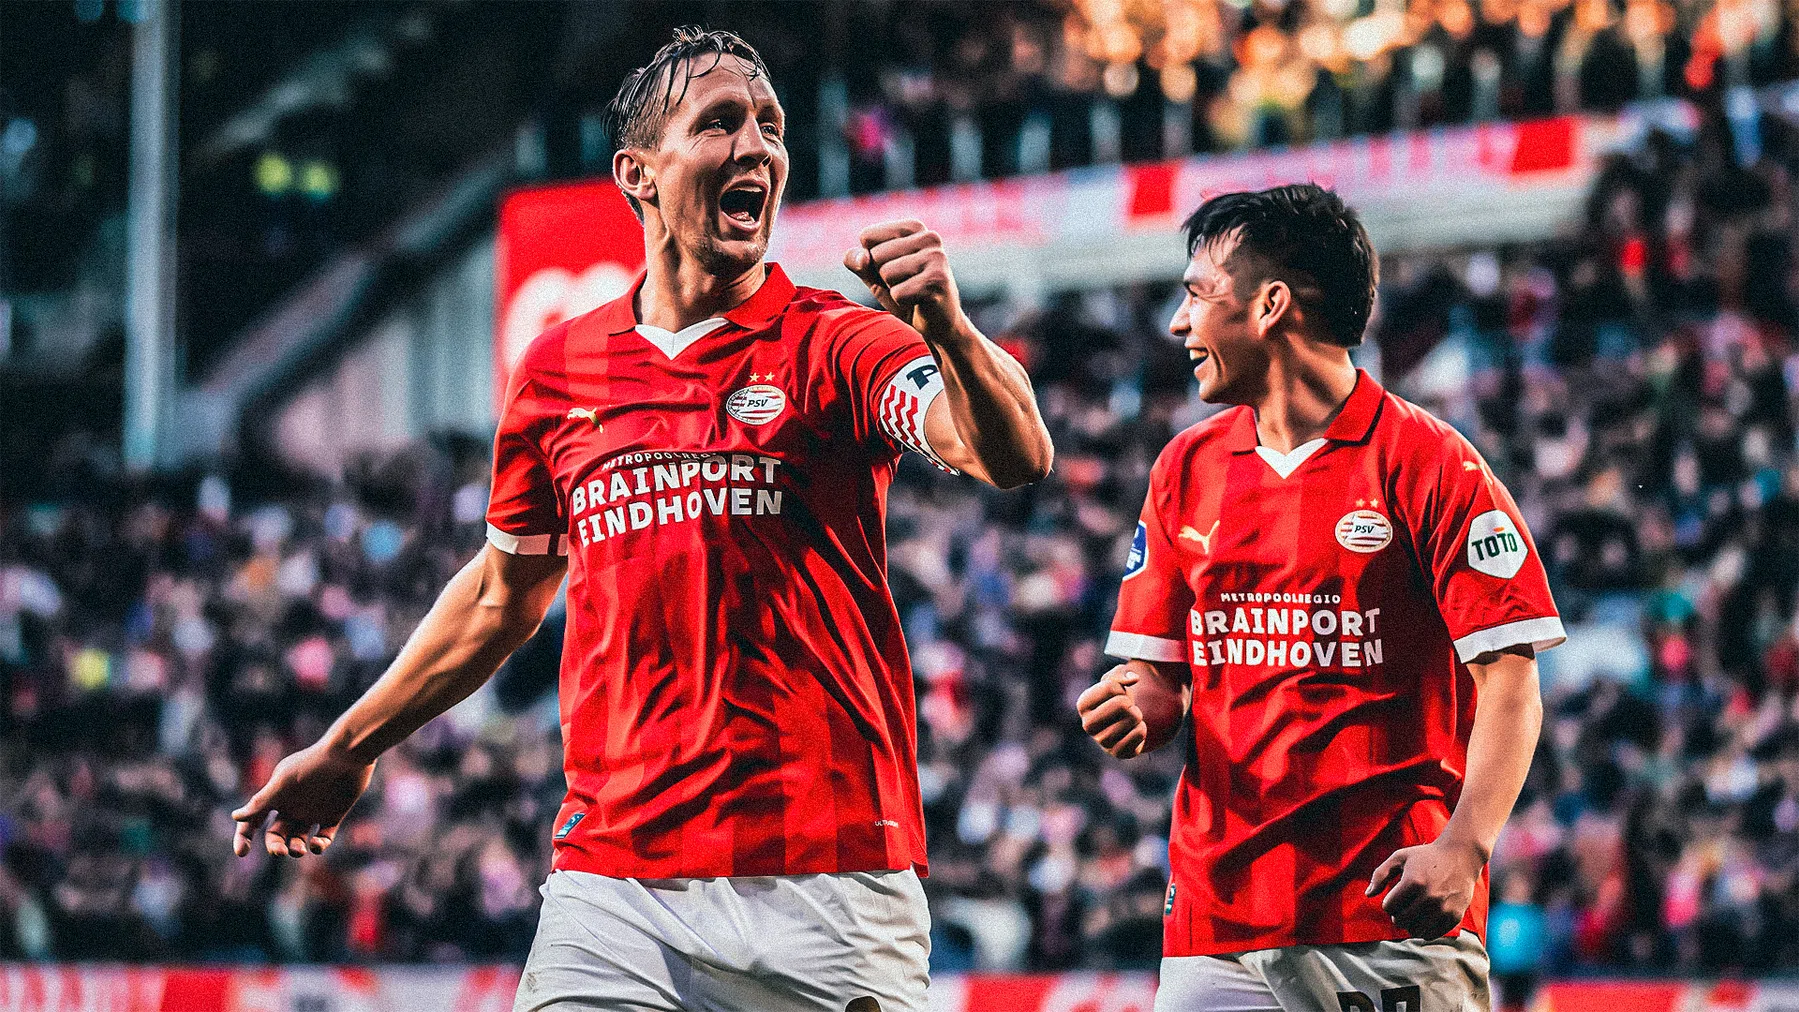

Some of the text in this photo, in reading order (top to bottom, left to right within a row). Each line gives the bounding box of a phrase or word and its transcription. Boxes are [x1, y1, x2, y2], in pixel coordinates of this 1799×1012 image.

[747, 399, 768, 408] PSV
[572, 454, 782, 516] BRAINPORT
[577, 487, 783, 548] EINDHOVEN
[1354, 525, 1375, 534] PSV
[1471, 532, 1518, 562] TOTO
[1220, 592, 1341, 604] METROPOOLREGIO
[1190, 607, 1380, 637] BRAINPORT
[1192, 639, 1384, 667] EINDHOVEN
